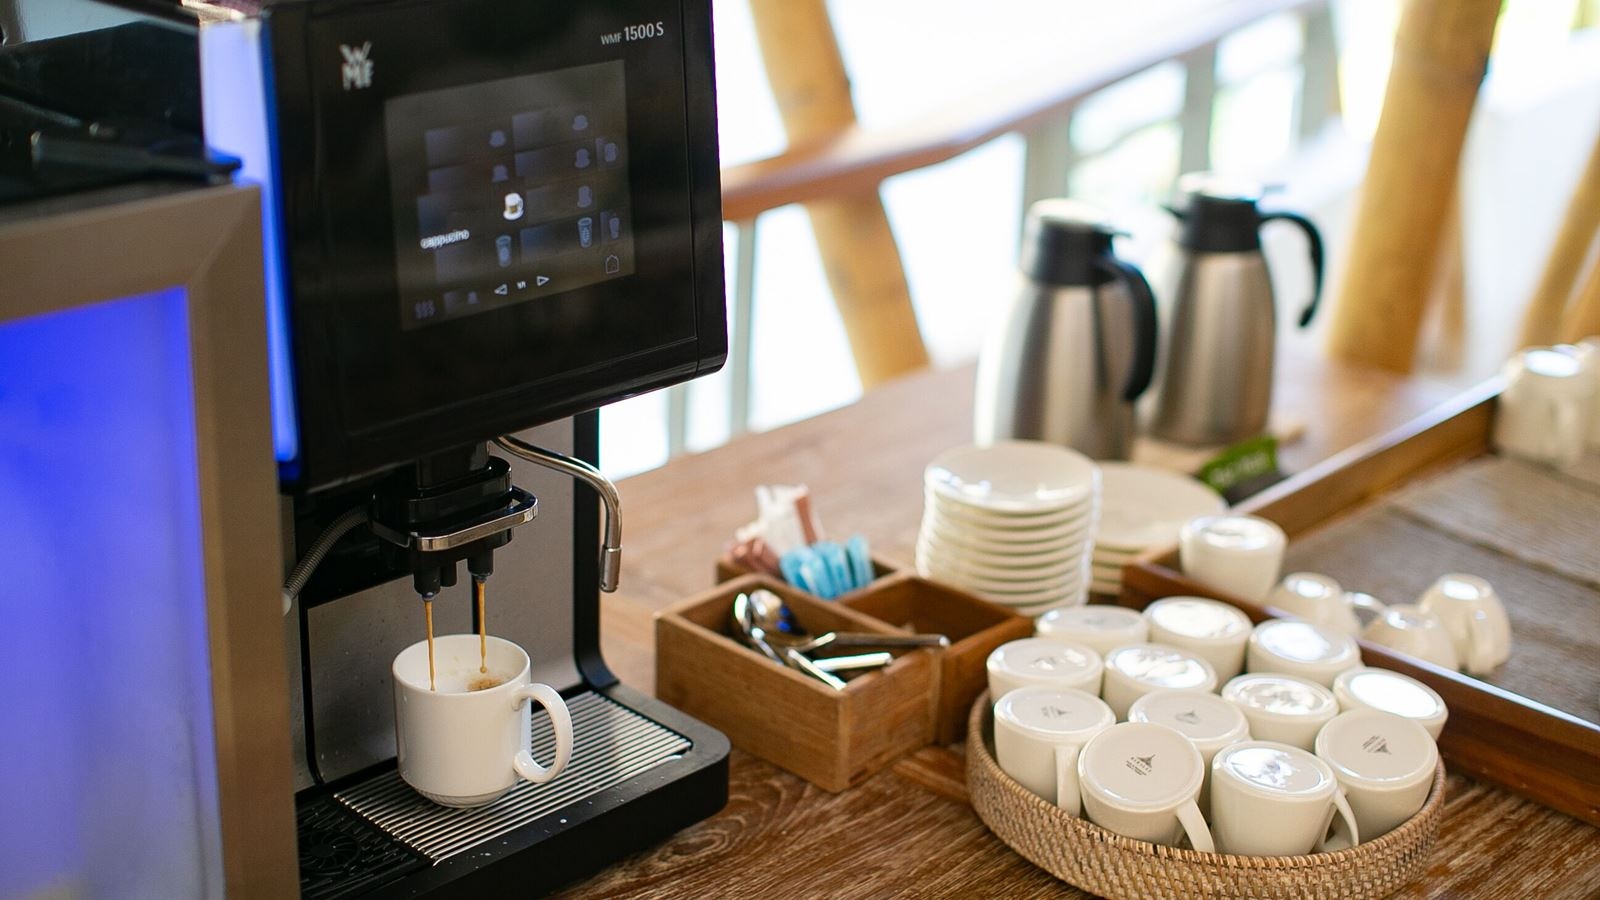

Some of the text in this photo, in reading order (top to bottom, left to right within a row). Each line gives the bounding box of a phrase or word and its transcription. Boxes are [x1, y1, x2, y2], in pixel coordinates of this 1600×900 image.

[600, 21, 665, 45] WMF 1500 S
